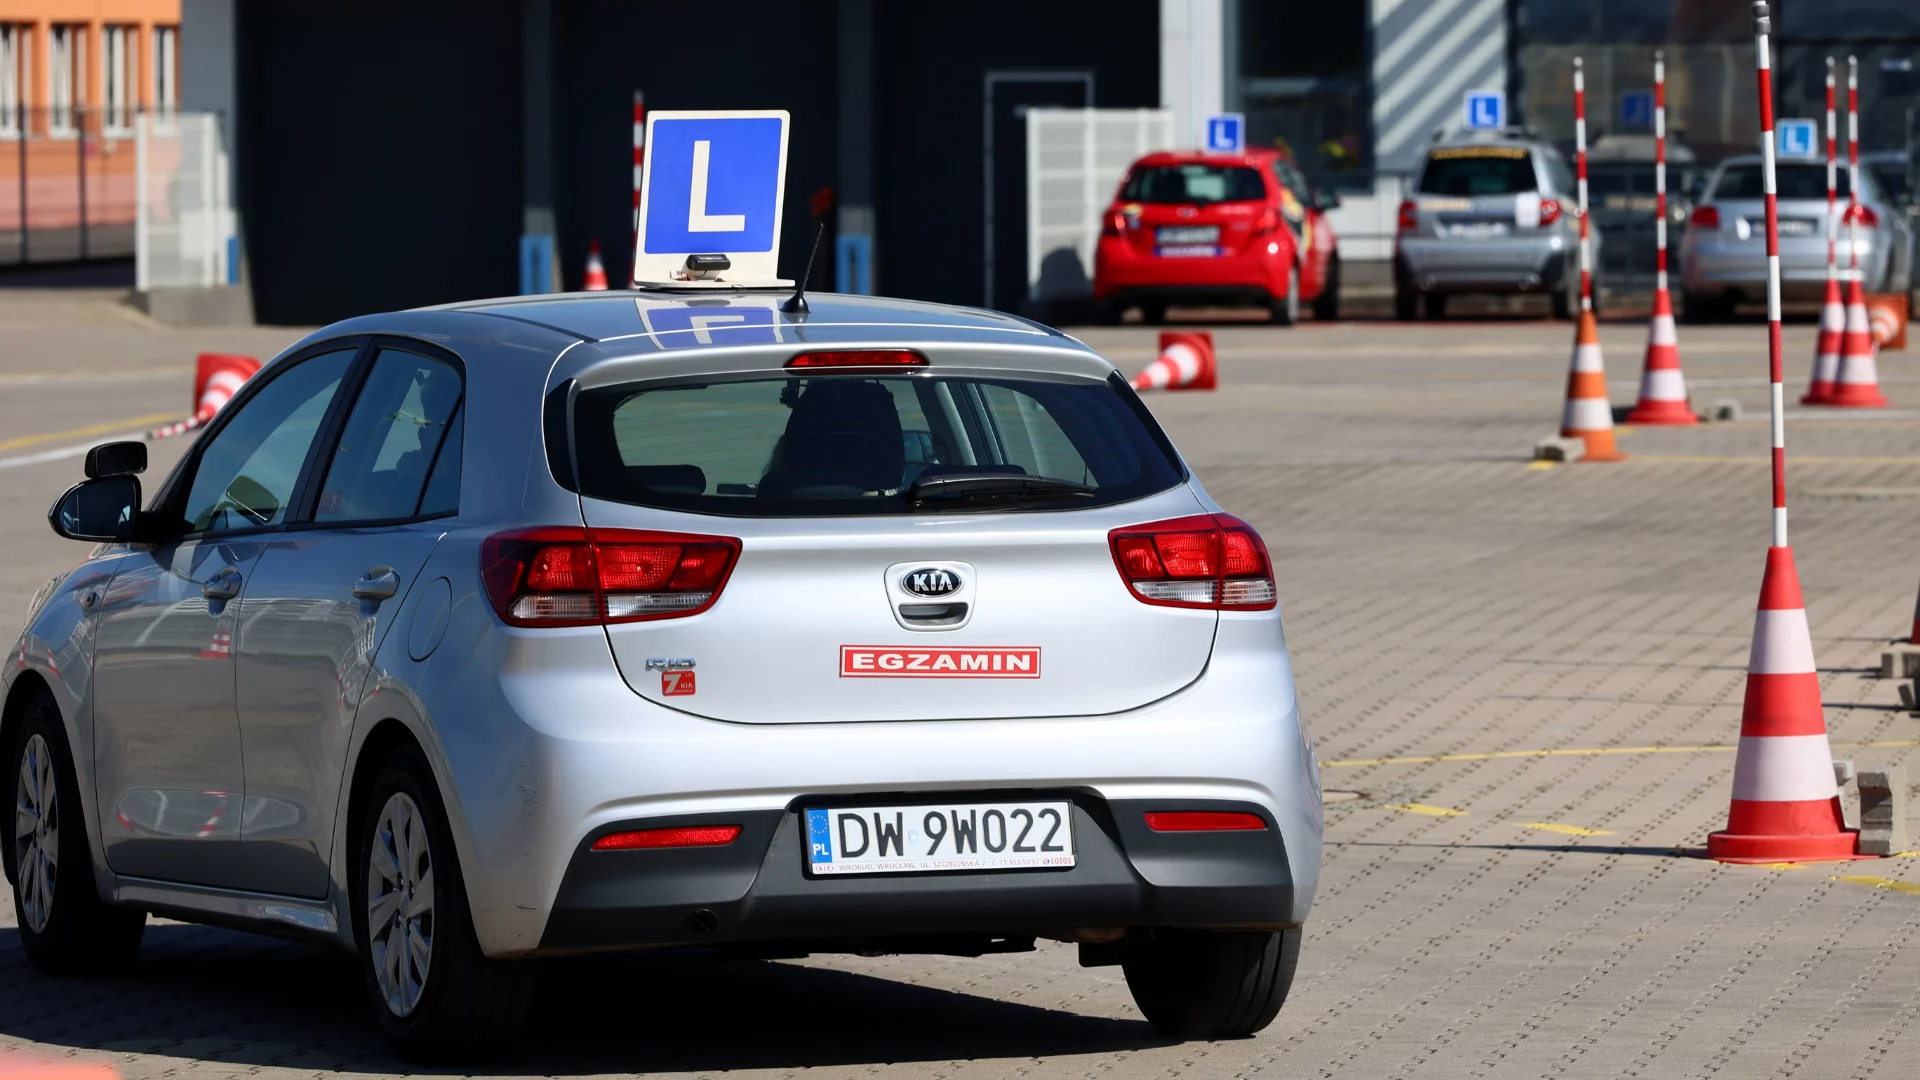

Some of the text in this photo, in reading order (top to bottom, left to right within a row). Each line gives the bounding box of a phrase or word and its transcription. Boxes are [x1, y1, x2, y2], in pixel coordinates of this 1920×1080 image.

[1476, 99, 1494, 124] L
[1215, 121, 1233, 148] L
[1787, 127, 1806, 151] L
[688, 140, 745, 232] L
[913, 573, 953, 591] KIA
[646, 658, 696, 669] RIO
[852, 653, 1030, 670] EGZAMIN
[664, 674, 681, 694] 7
[837, 808, 1064, 858] DW 9W022
[812, 843, 829, 856] PL
